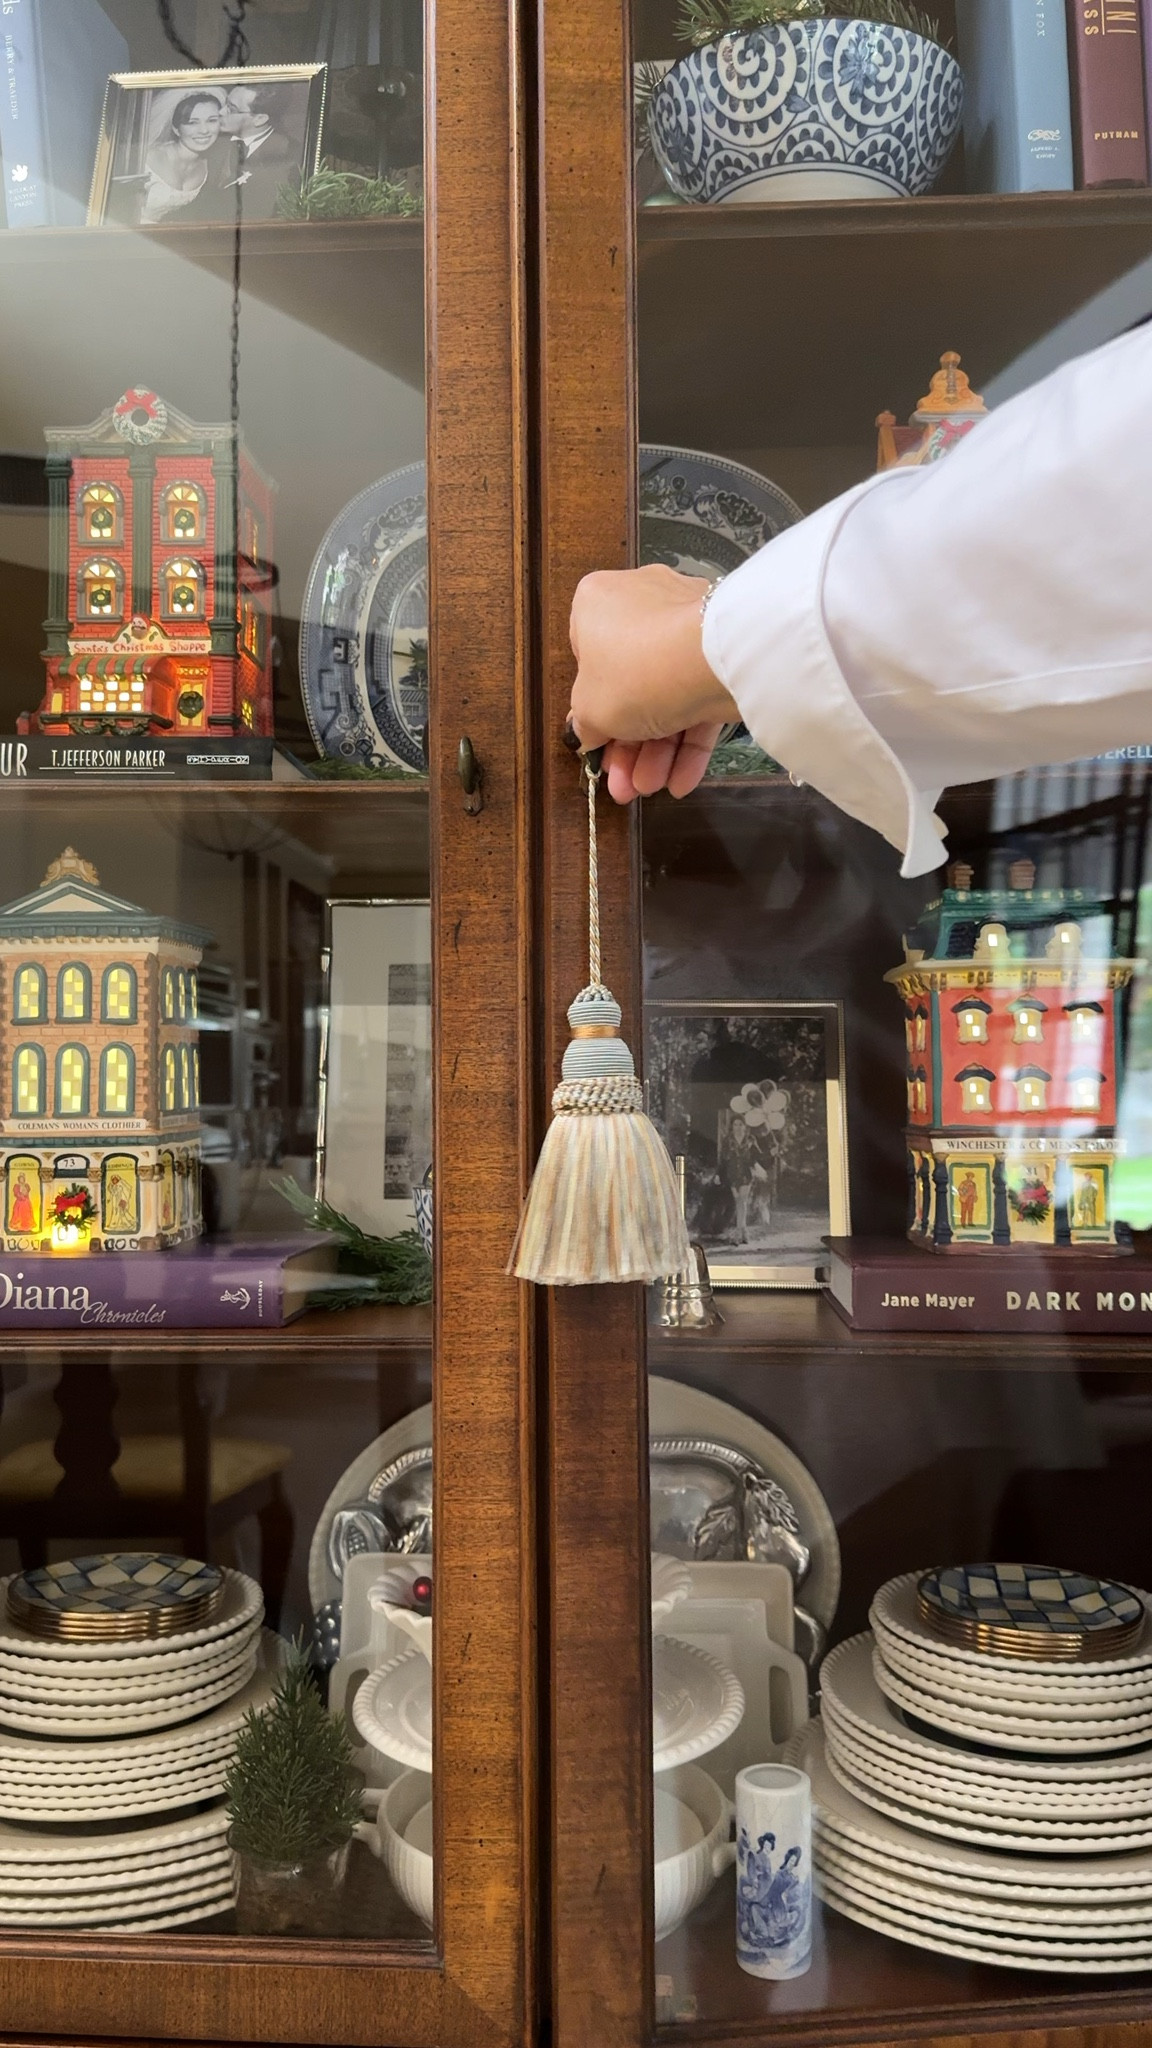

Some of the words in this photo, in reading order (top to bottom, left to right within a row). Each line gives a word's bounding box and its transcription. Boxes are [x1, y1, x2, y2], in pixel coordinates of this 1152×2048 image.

[1083, 0, 1099, 36] SS
[5, 34, 15, 65] BERRY
[8, 67, 15, 75] &
[1094, 130, 1139, 140] PUTNAM
[113, 642, 164, 653] Christmas
[170, 641, 206, 653] Shoppe
[125, 749, 166, 768] PARKER
[17, 1122, 60, 1131] COLEMAN'S
[63, 1122, 99, 1130] WOMAN'S
[101, 1121, 141, 1130] CLOTHIER
[946, 1140, 1012, 1150] WINCHESTE
[63, 1158, 76, 1168] 73
[881, 1292, 920, 1307] Jane
[925, 1292, 976, 1310] Mayer
[1006, 1291, 1082, 1311] DARK
[80, 1301, 167, 1324] Chronicles
